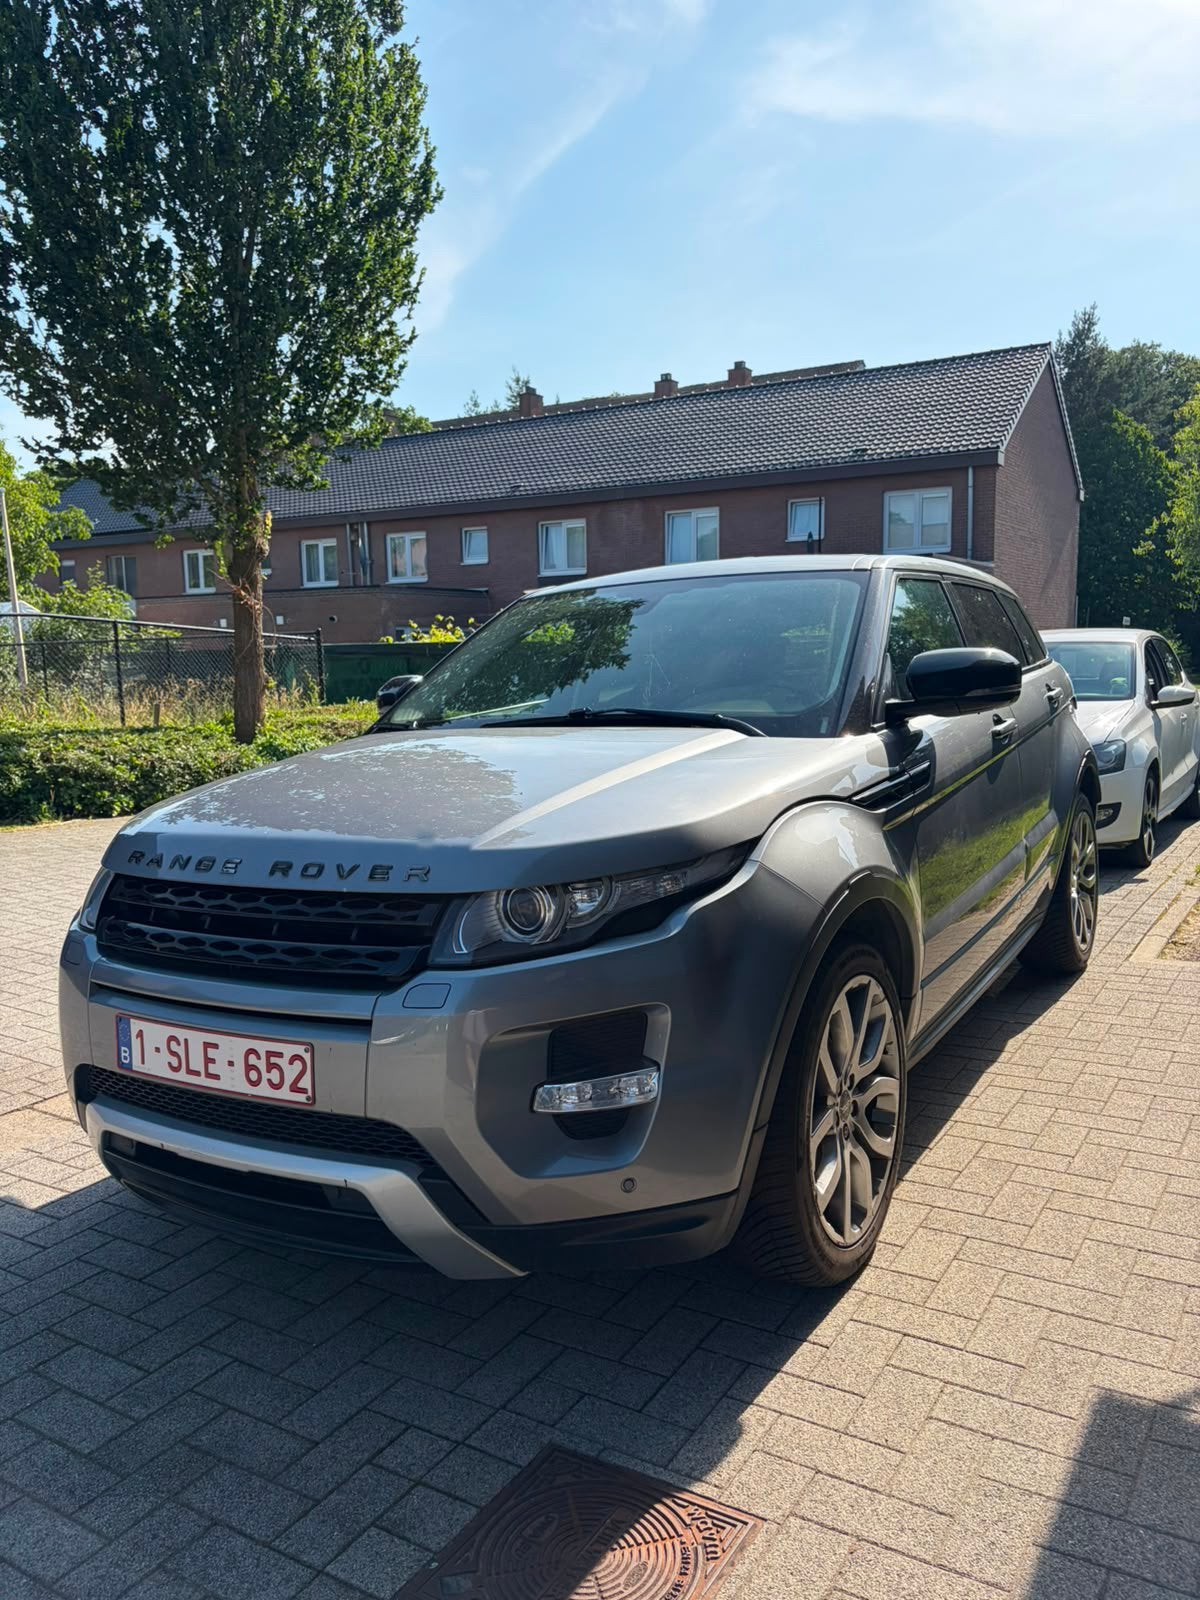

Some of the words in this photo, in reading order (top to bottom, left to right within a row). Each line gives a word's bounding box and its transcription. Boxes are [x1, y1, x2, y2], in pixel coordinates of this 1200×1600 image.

[127, 849, 242, 874] RANGE
[268, 860, 431, 882] ROVER
[121, 1046, 130, 1064] B
[135, 1029, 309, 1095] 1-SLE-652
